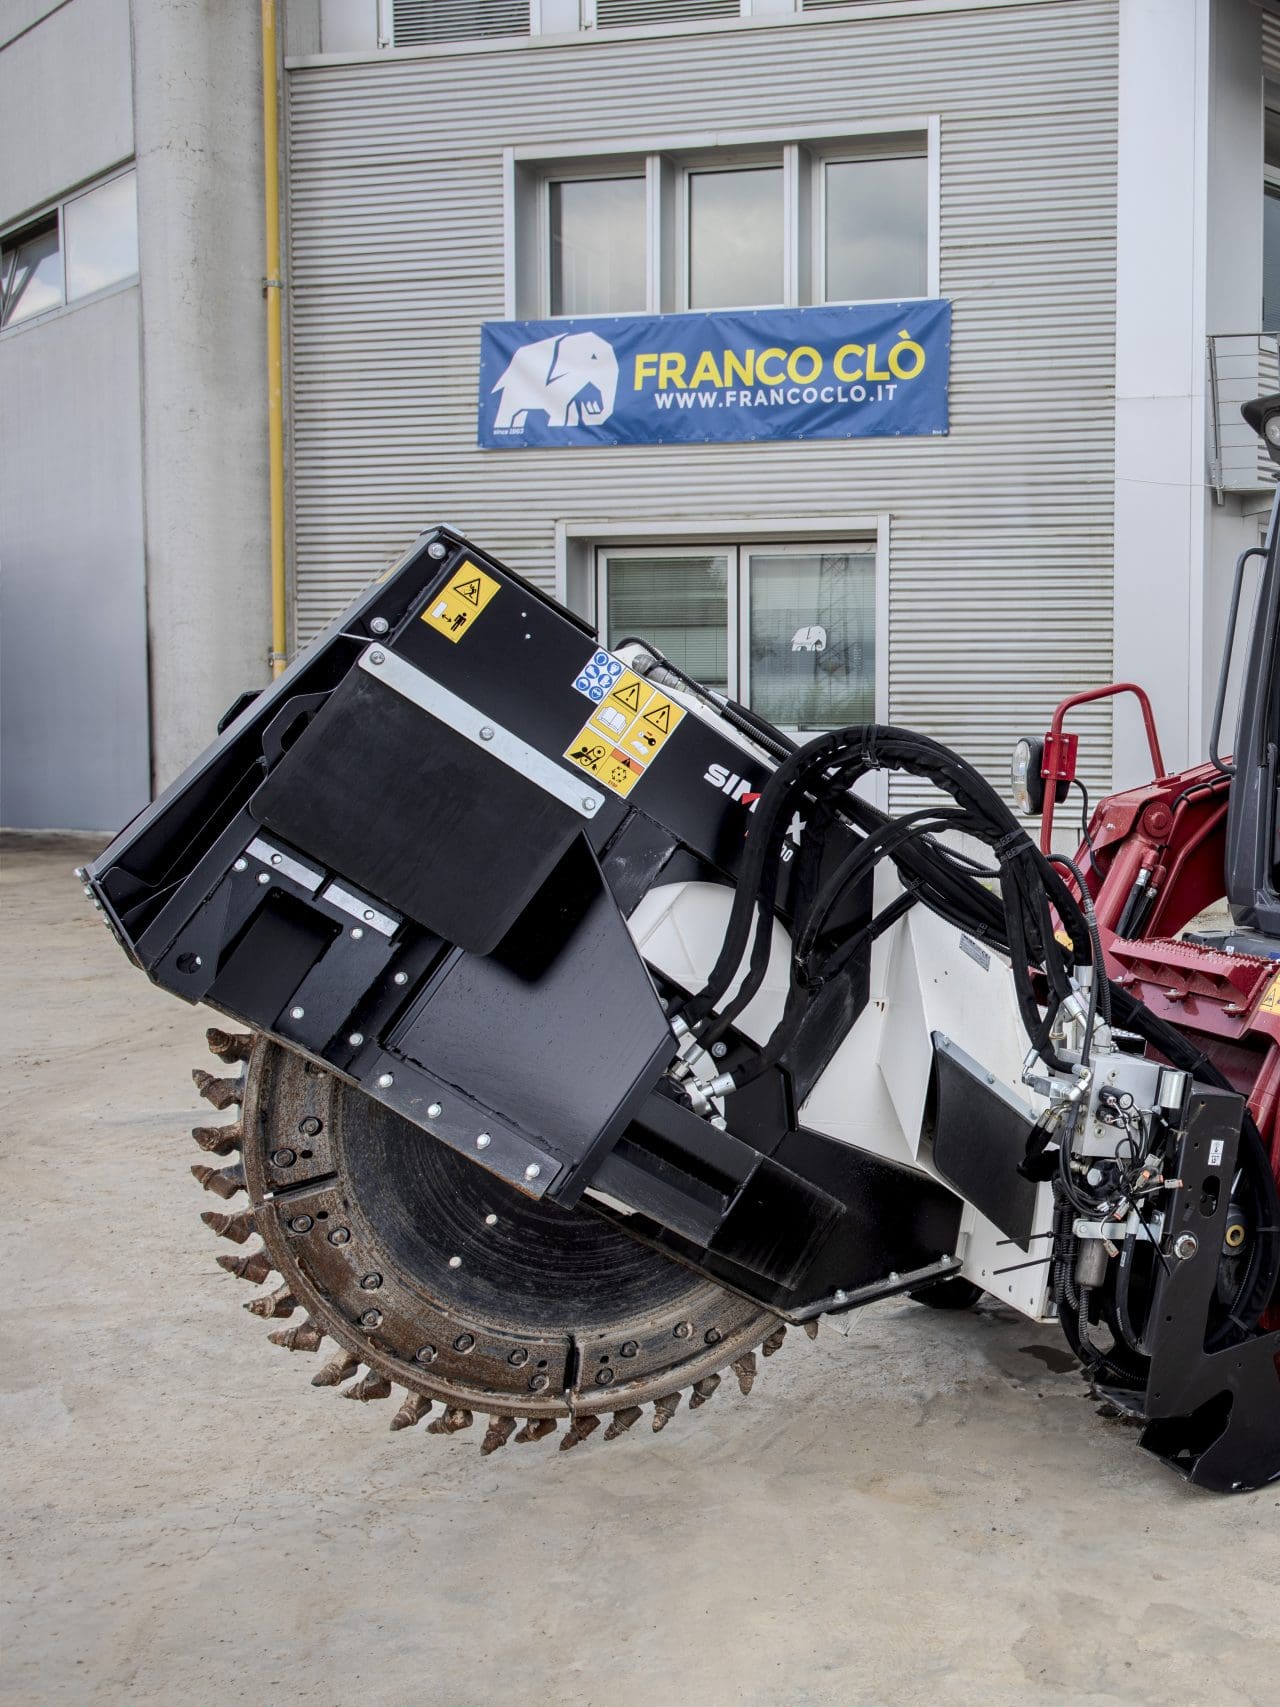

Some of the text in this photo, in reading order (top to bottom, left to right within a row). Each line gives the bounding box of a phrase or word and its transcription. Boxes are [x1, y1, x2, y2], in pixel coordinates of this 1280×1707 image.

[633, 329, 926, 391] FRANCO CLÒ
[654, 384, 898, 410] WWW.FRANCOCLO.IT
